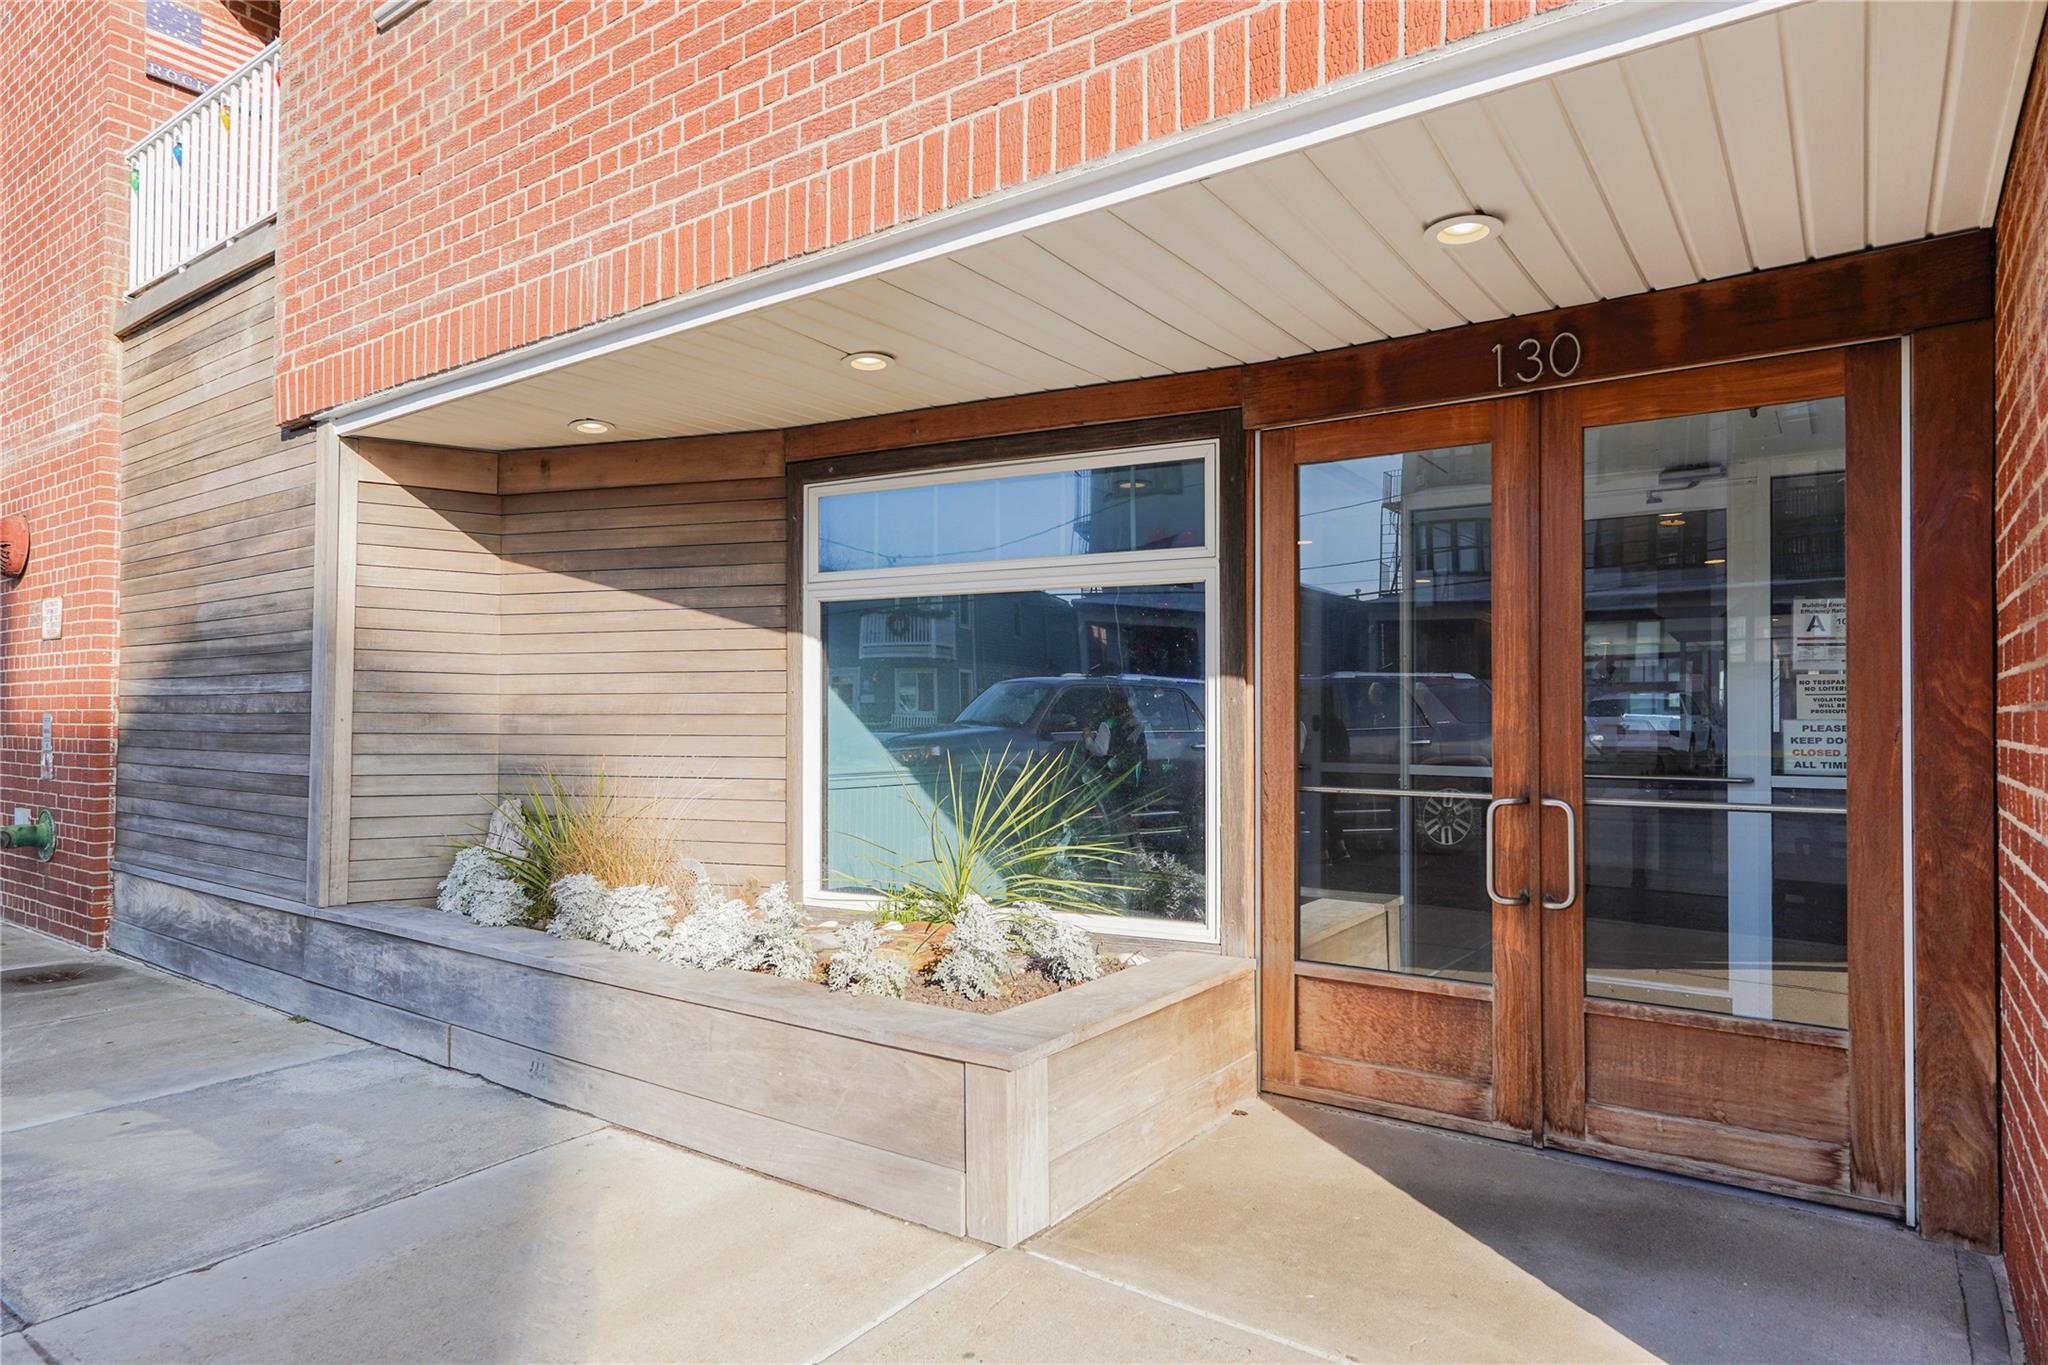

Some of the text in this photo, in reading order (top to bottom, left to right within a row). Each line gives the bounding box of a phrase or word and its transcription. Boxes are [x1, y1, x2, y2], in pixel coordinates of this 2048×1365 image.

[1491, 332, 1581, 388] 130
[1806, 615, 1826, 632] A
[1792, 749, 1841, 757] CLOSED
[1793, 761, 1817, 769] ALL
